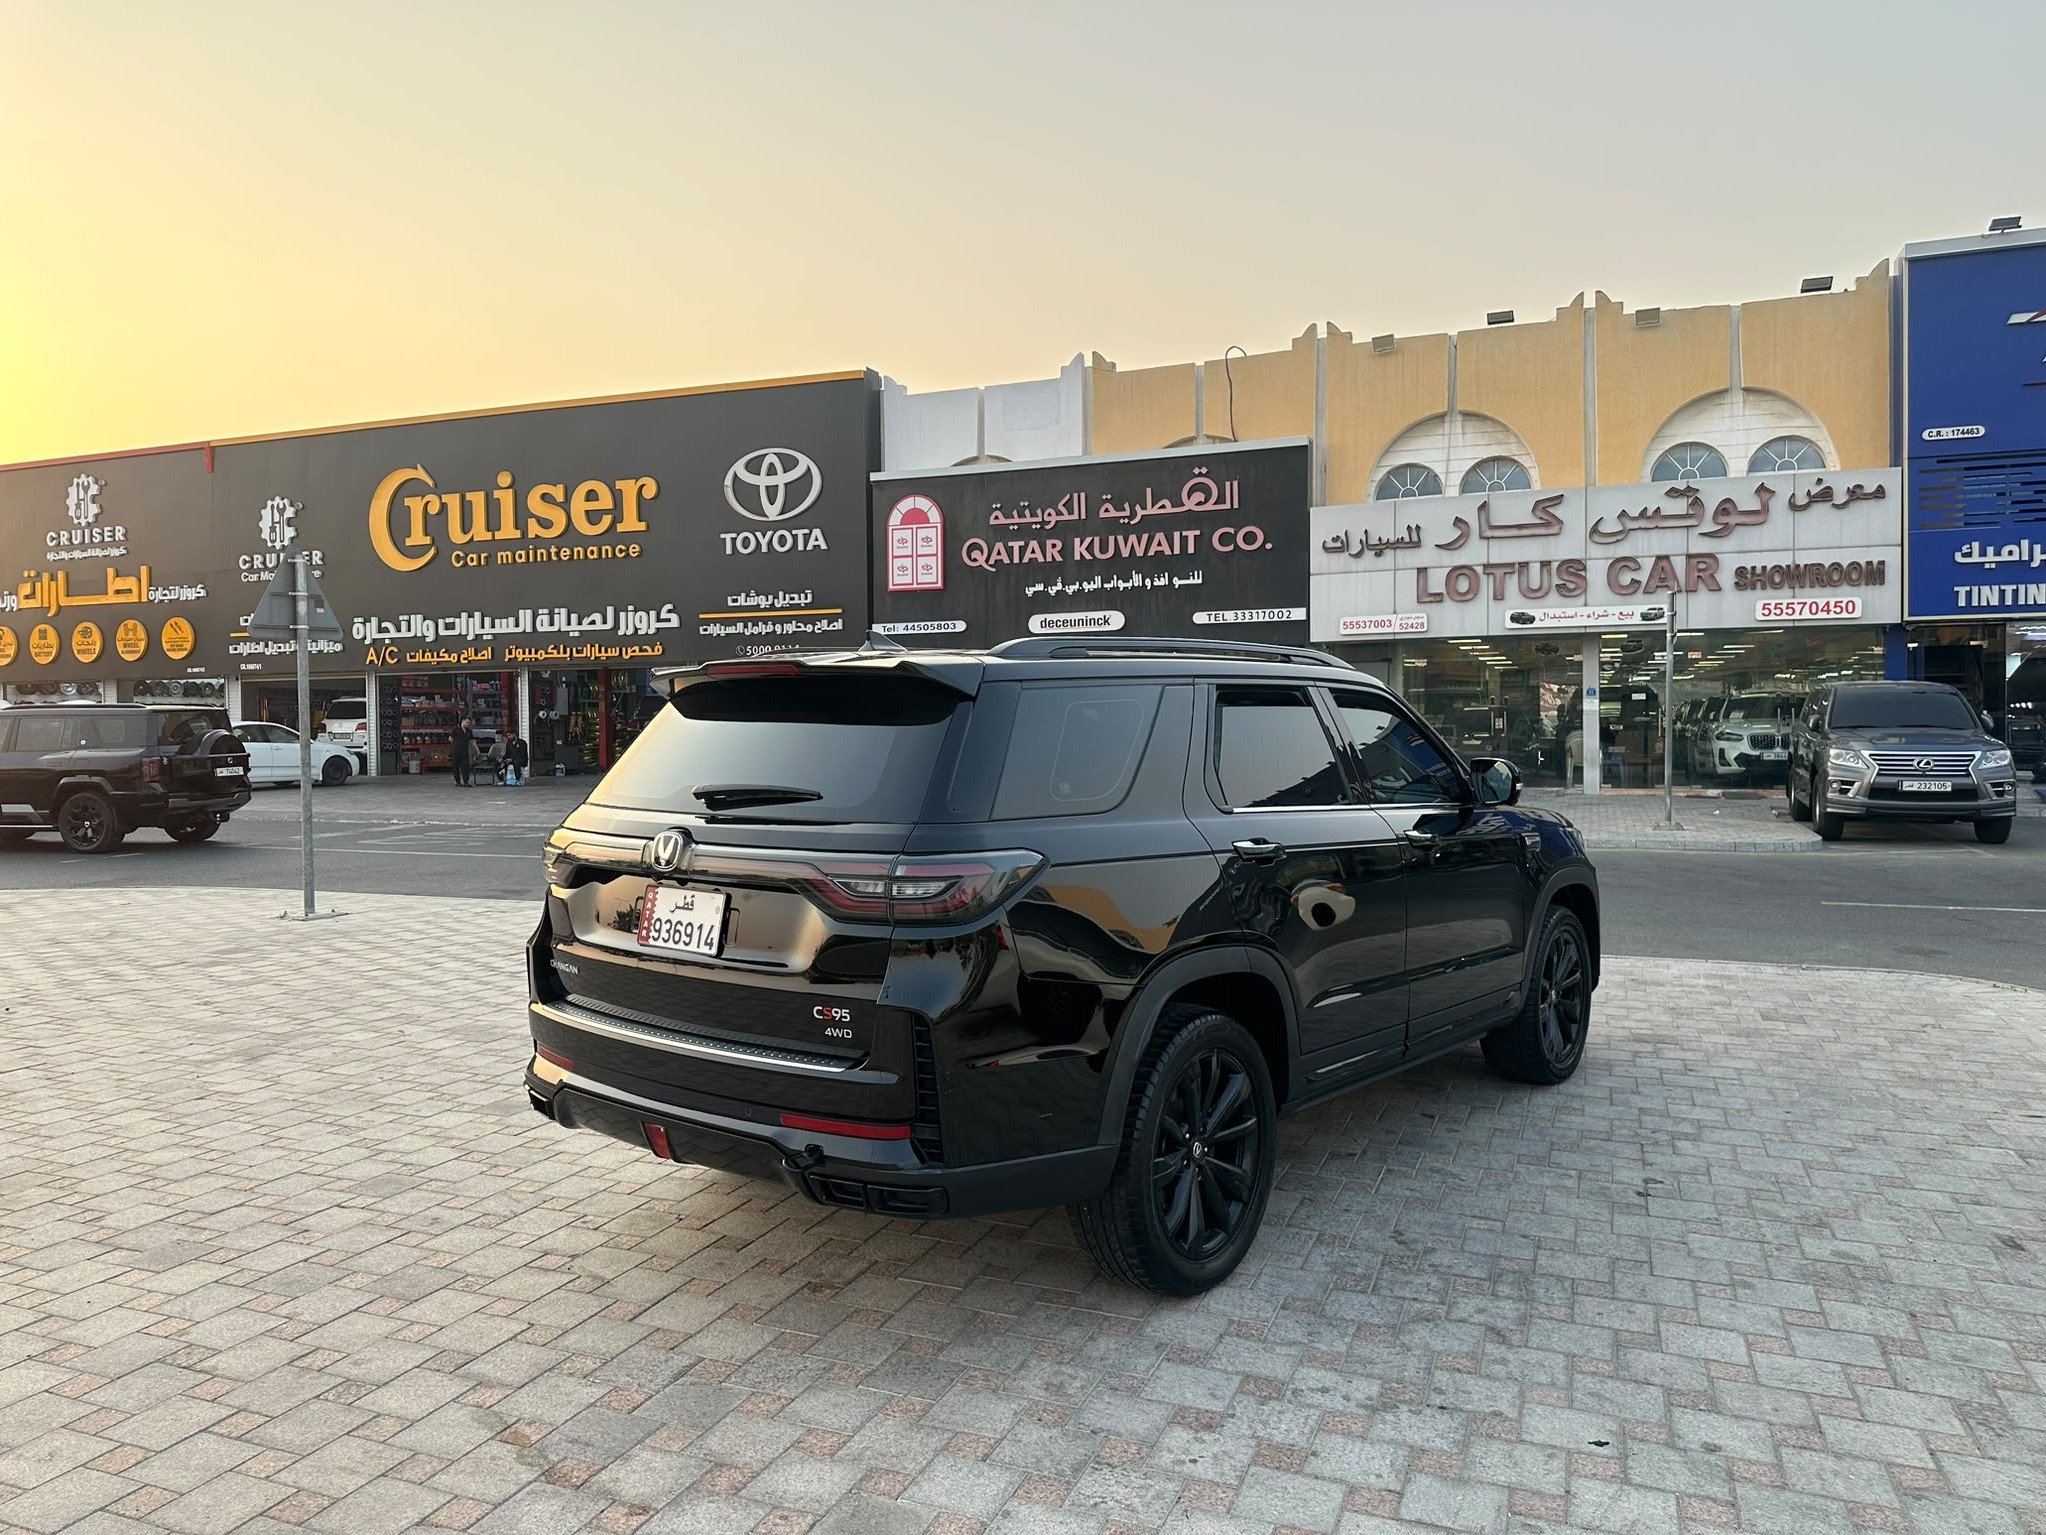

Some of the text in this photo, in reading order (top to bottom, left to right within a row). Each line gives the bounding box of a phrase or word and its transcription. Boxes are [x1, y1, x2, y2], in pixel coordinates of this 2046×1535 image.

[989, 466, 1239, 530] القطرية الكويتية
[368, 463, 659, 572] Cruiser
[1322, 477, 1886, 559] معرض لوتس كار للسيارات
[46, 526, 127, 547] CRUISER
[720, 528, 828, 555] TOYOTA
[451, 543, 642, 568] Car maintenance
[961, 526, 1273, 572] QATAR KUWAIT CO.
[1417, 552, 1886, 604] LOTUS CAR SHOWROOM
[774, 590, 813, 607] تبديل
[1618, 611, 1635, 621] بيع
[1761, 599, 1856, 617] 55570450
[352, 603, 681, 645] كروزر لصيانة السيارات والتجارة
[699, 622, 745, 637] السيارات
[903, 622, 956, 631] 44505803
[1040, 614, 1111, 629] deceuninck
[1343, 619, 1392, 630] 55537003
[1399, 622, 1425, 630] 52428
[366, 645, 492, 667] اصلاح مكيفات A/C
[573, 643, 619, 661] سيارات
[622, 642, 664, 660] فحص
[1917, 782, 1948, 790] 232105
[669, 894, 695, 913] قطر
[641, 892, 654, 937] QATAR
[652, 917, 714, 950] 936914
[813, 1006, 850, 1022] CS95
[824, 1027, 852, 1039] 4WD
